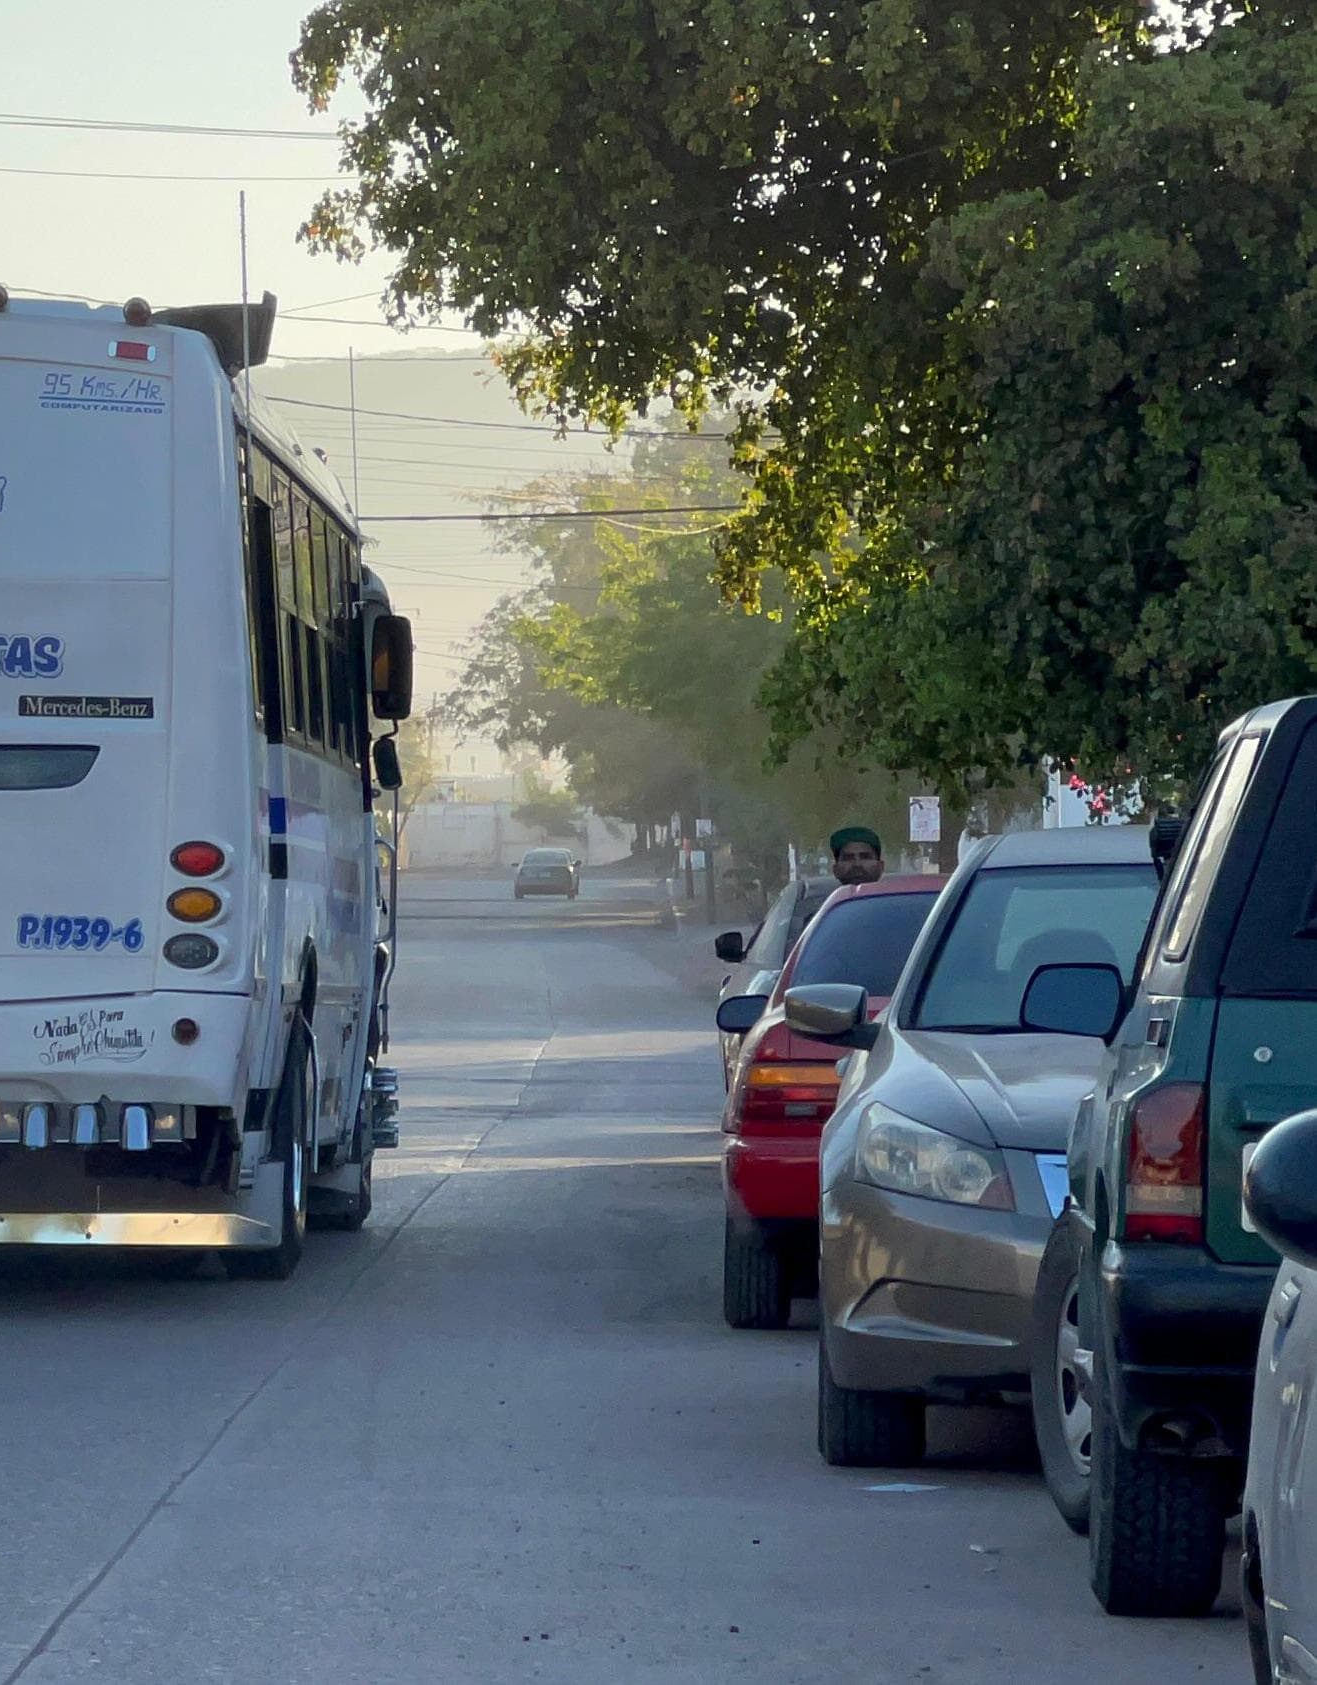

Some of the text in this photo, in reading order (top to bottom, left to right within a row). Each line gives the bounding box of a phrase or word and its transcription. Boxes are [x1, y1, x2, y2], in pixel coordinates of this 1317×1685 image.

[42, 372, 73, 396] 95
[40, 401, 163, 415] COMPUTARIZADO
[25, 697, 147, 717] Mercedes-Benz
[17, 914, 144, 952] P.1939-6
[34, 1016, 78, 1038] Nada
[99, 1010, 123, 1027] Para
